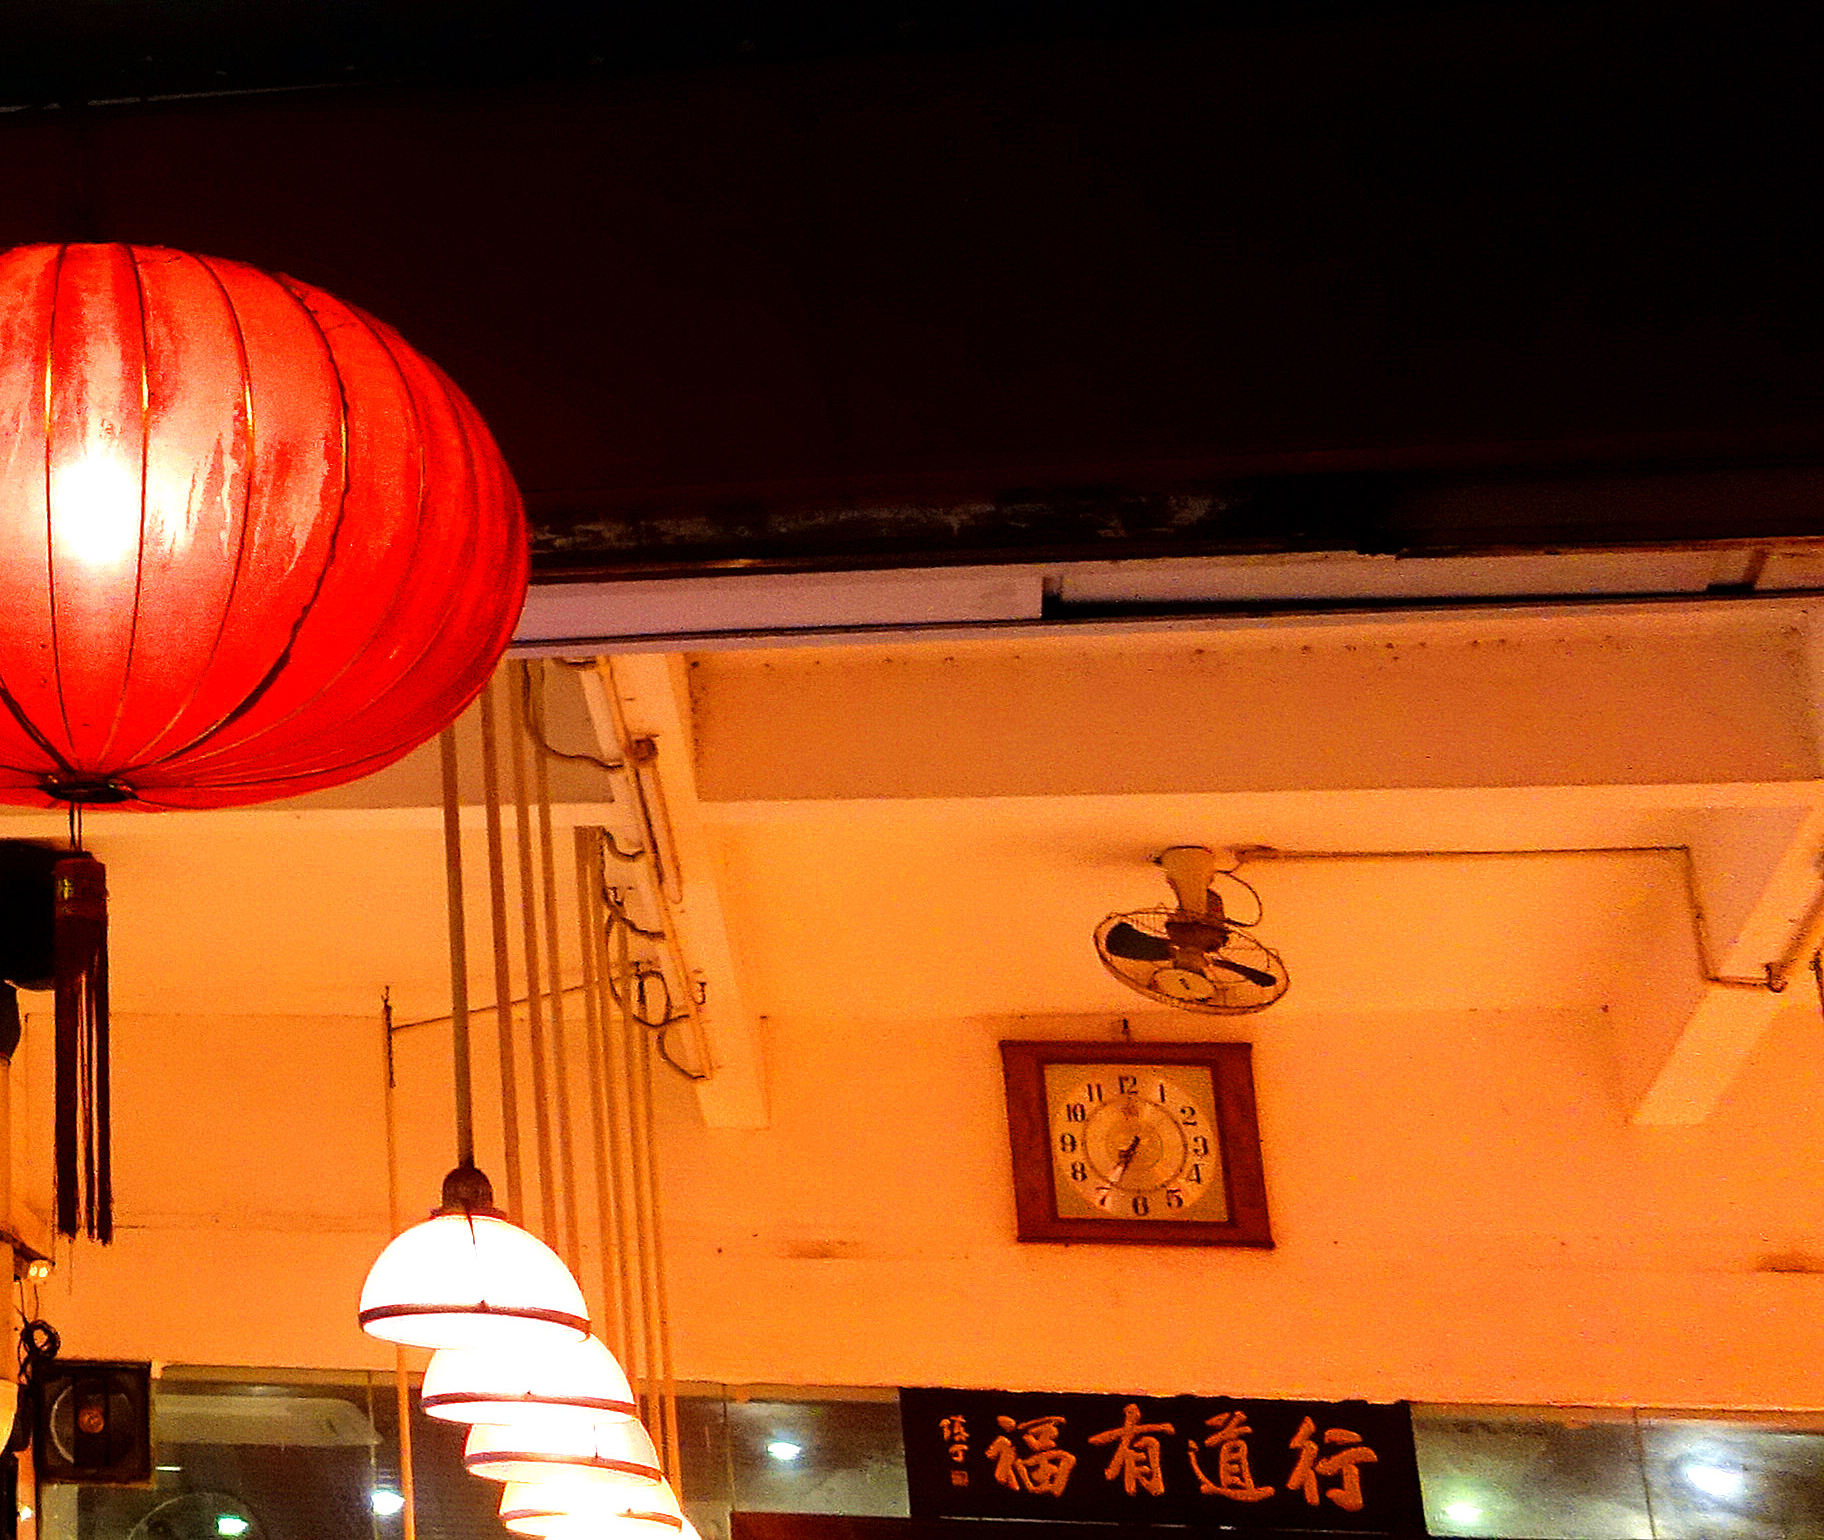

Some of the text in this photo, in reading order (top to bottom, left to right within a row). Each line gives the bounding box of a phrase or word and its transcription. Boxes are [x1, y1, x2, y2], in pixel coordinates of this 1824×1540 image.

[1087, 1083, 1103, 1102] 11
[1118, 1075, 1138, 1095] 12
[1159, 1083, 1166, 1103] 1
[1066, 1103, 1086, 1122] 10
[1180, 1105, 1198, 1126] 2
[1060, 1133, 1077, 1153] 9
[1193, 1135, 1209, 1157] 3
[1071, 1161, 1088, 1182] 8
[1187, 1163, 1202, 1184] 4
[1095, 1186, 1112, 1206] 7
[1166, 1188, 1184, 1209] 5
